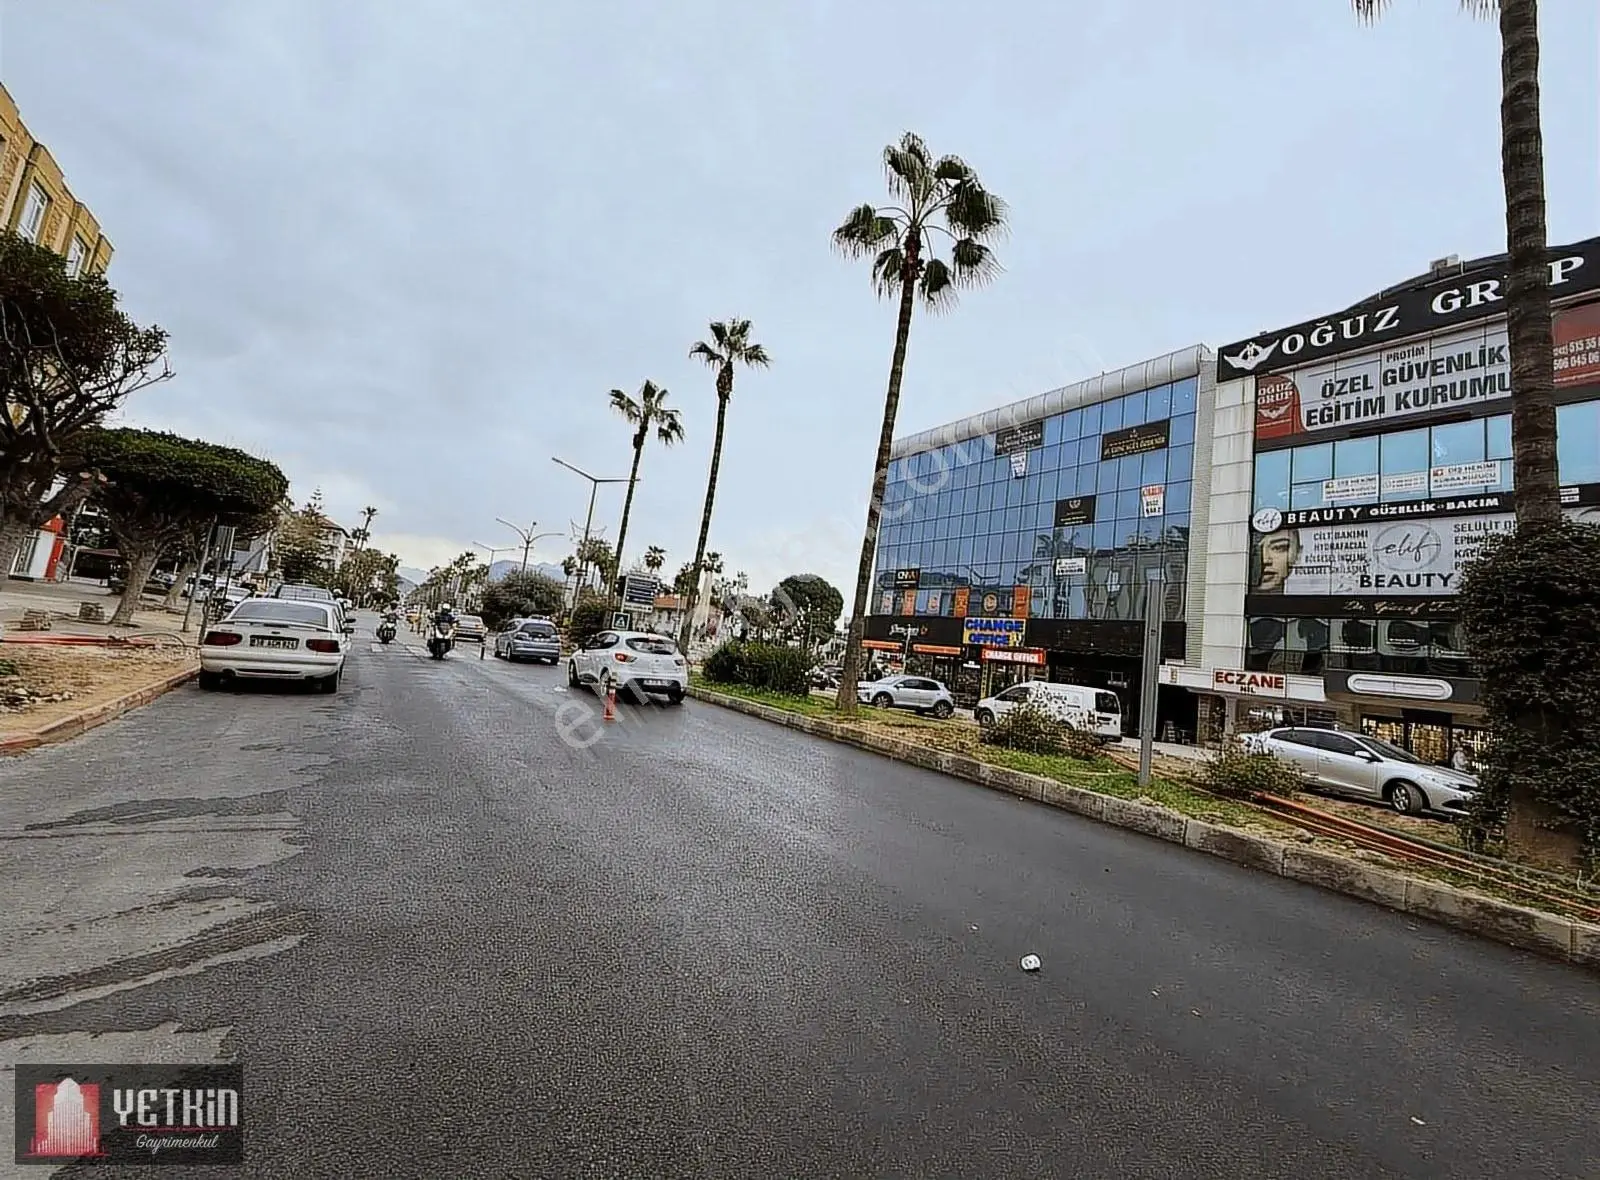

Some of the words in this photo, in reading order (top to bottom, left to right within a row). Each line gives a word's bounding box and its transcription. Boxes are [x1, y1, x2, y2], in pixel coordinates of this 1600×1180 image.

[1282, 305, 1400, 354] OĞUZ
[1432, 256, 1585, 314] GRP
[1321, 374, 1374, 398] ÖZEL
[1383, 345, 1506, 387] GÜVENLİK
[1306, 395, 1385, 427] EĞİTİM
[1287, 507, 1363, 524] BEAUTY
[1369, 501, 1436, 516] GÜZELLİK
[1446, 497, 1499, 510] BAKIM
[1359, 572, 1454, 589] BEAUTY
[966, 618, 1024, 632] CHANGE
[969, 632, 1009, 645] OFFICE
[1215, 671, 1285, 689] ECZANE
